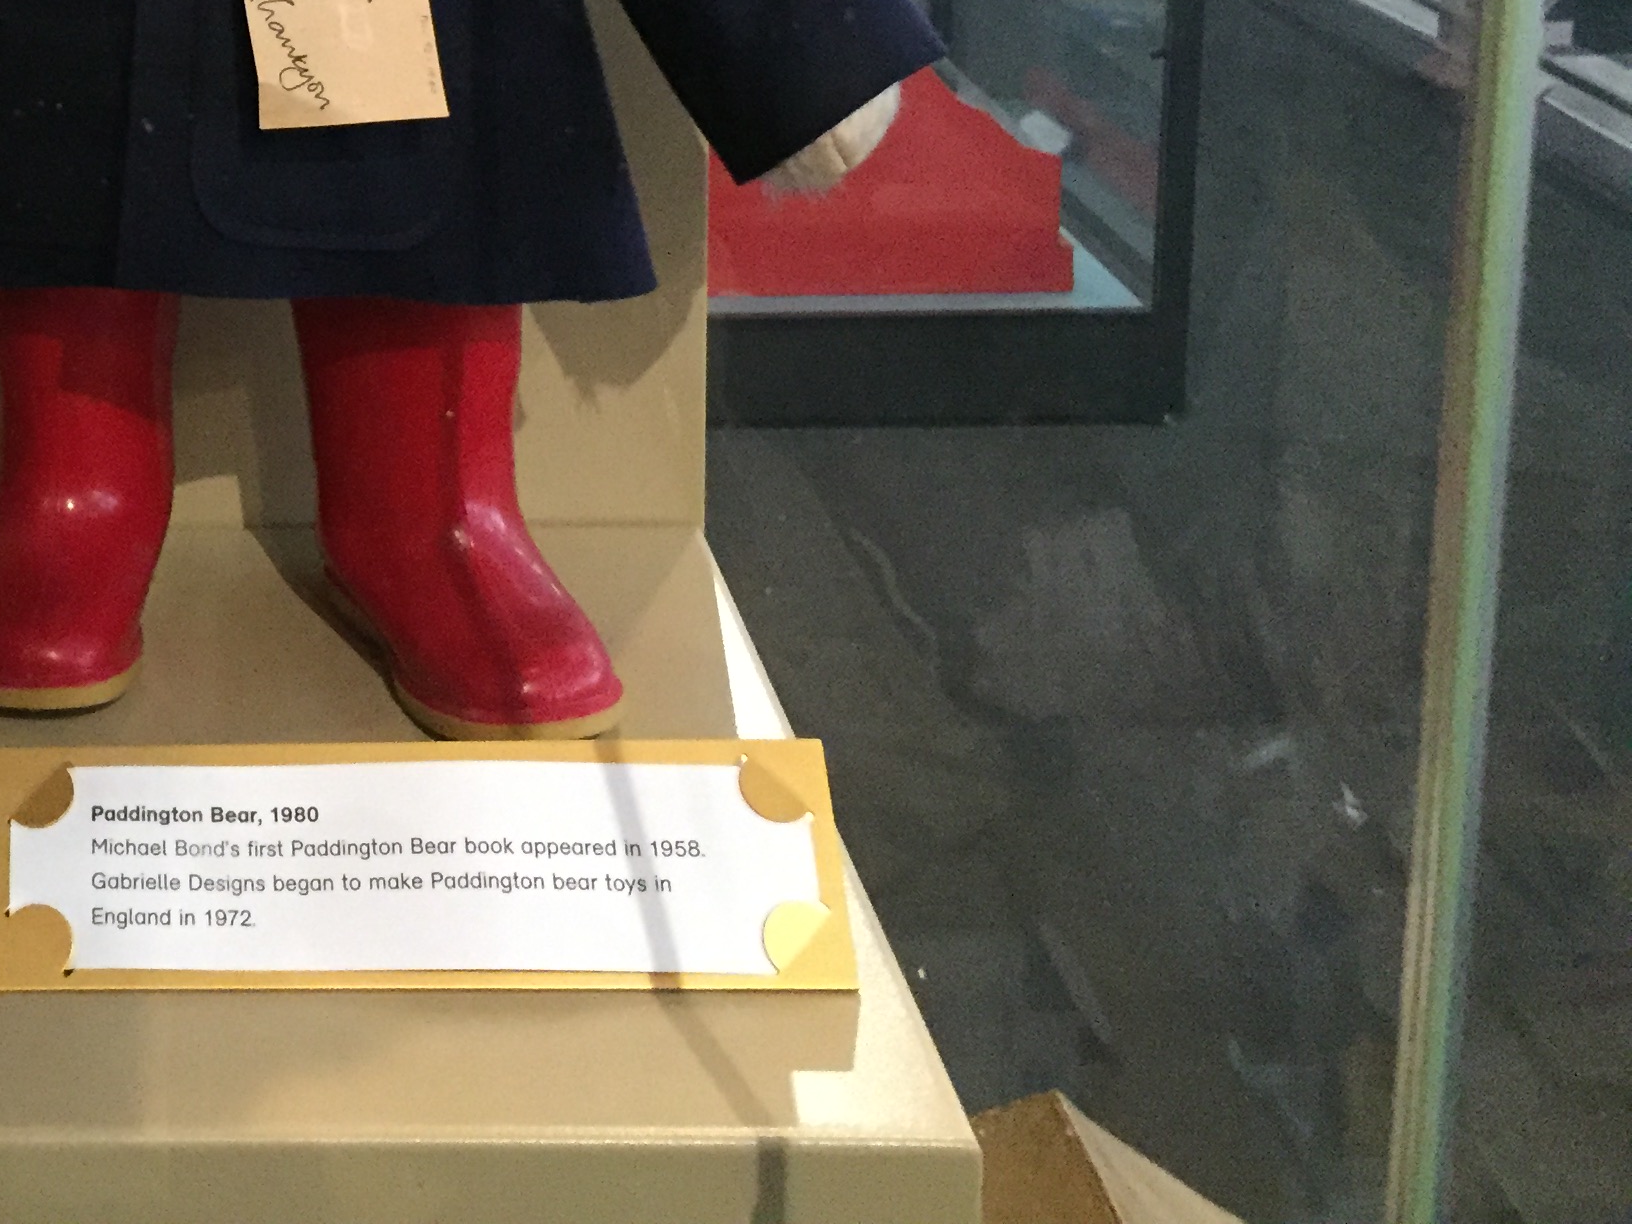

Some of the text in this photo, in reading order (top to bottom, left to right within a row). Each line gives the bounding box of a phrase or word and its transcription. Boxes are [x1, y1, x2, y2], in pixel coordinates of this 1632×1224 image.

[91, 804, 319, 826] Paddington Bear, 1980
[91, 836, 706, 861] Michael Bond's first Paddington Bear book appeared in 1958.
[91, 871, 672, 896] Gabrielle Designs began to make Paddington bear toys in
[91, 907, 256, 930] England in 1972.
